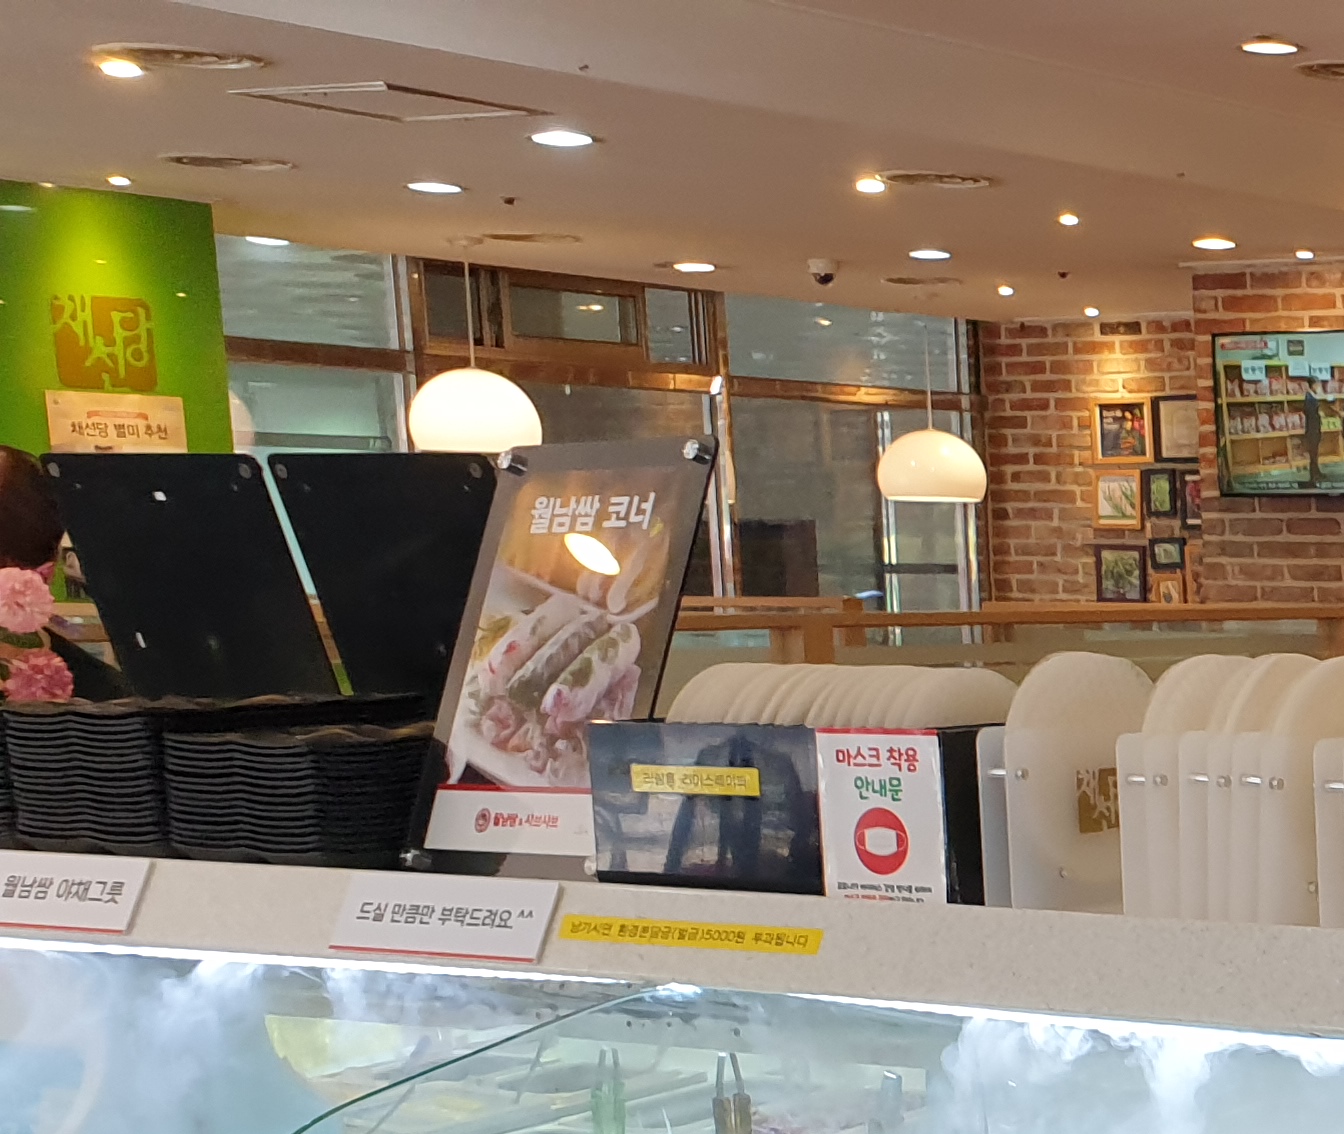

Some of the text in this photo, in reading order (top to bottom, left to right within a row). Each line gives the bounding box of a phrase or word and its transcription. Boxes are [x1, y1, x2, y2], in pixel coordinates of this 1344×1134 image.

[529, 490, 657, 534] 월남쌈 코너
[835, 746, 919, 773] 마스크 착용
[853, 775, 904, 802] 안내문
[1075, 767, 1119, 834] 채선
[1, 874, 126, 905] 월남쌈 야채그릇
[356, 901, 389, 923] 드실
[390, 903, 436, 926] 만큼만
[751, 931, 809, 949] 부과됩니다
